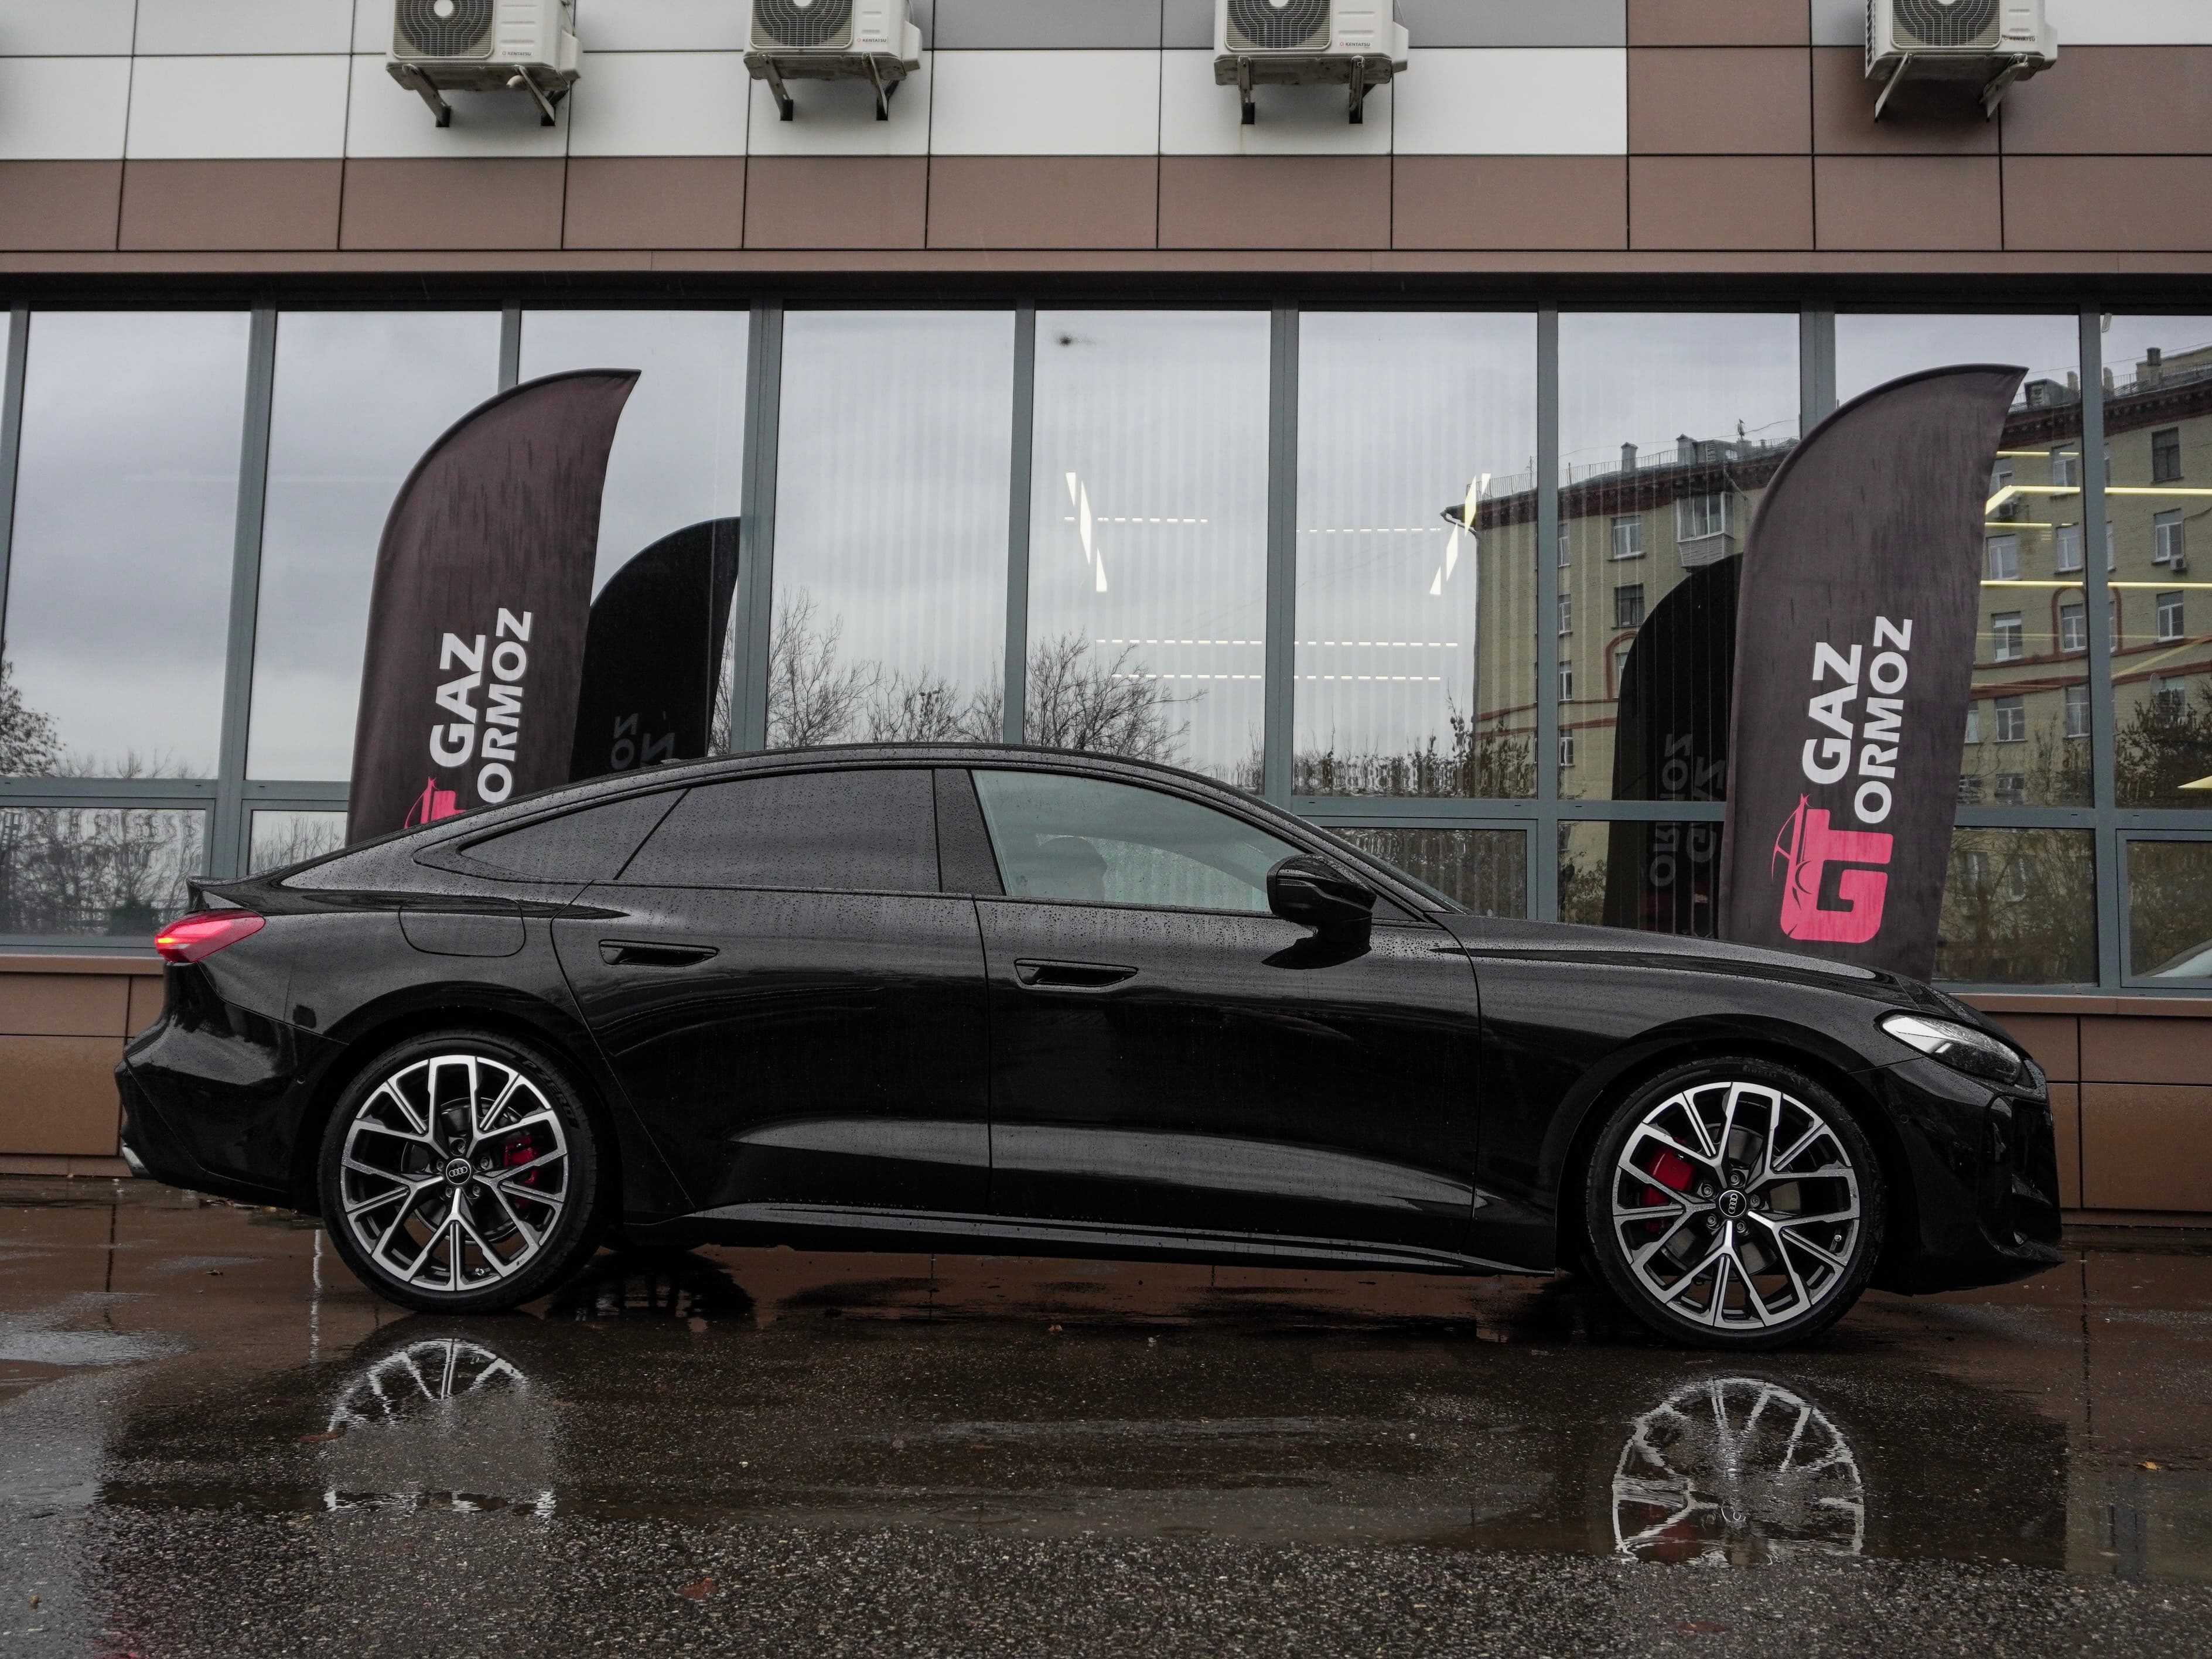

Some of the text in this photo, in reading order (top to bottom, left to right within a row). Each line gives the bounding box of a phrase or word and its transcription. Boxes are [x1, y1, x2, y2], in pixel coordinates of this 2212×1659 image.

[430, 633, 486, 767] GAZ
[477, 608, 531, 803] ORMOZ
[1803, 642, 1862, 784] GAZ
[1855, 616, 1912, 823] ORMOZ
